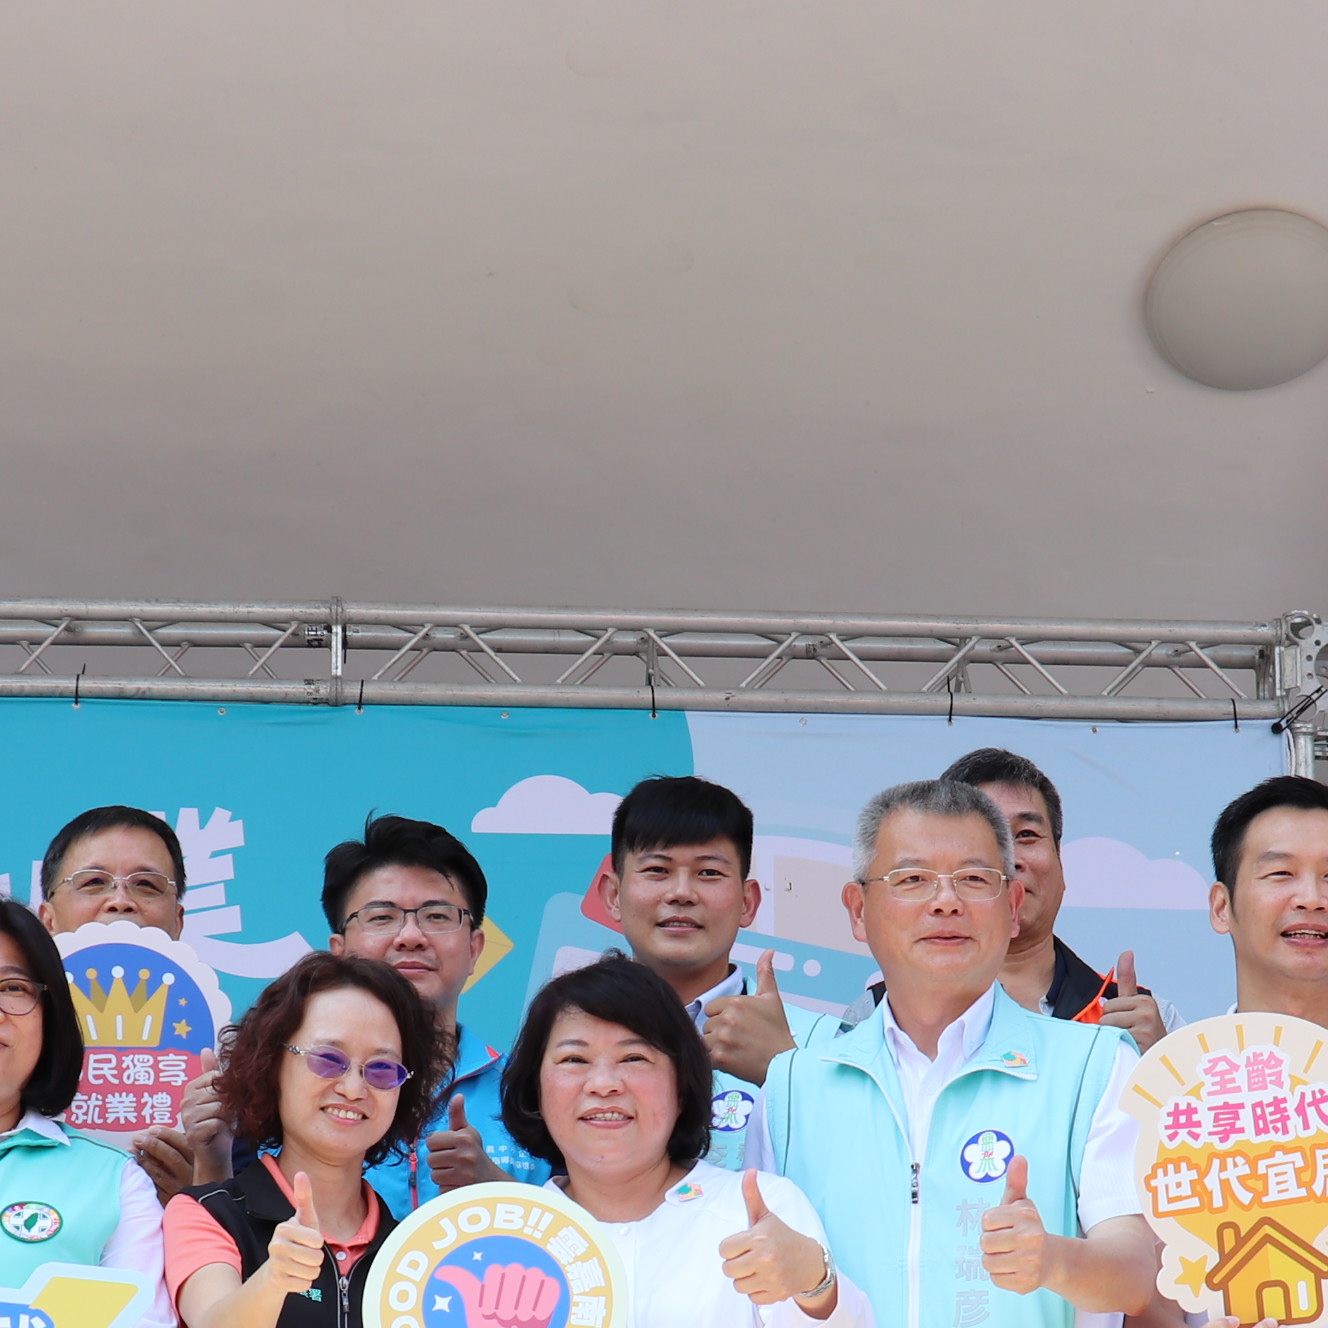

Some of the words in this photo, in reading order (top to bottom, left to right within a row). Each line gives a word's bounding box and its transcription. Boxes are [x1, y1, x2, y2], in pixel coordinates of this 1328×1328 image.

[80, 1053, 188, 1086] 民獨享
[1203, 1051, 1285, 1097] 全齡
[70, 1092, 173, 1125] 就業禮
[432, 1203, 555, 1250] JOB!!
[546, 1225, 607, 1328] 雲嘉南
